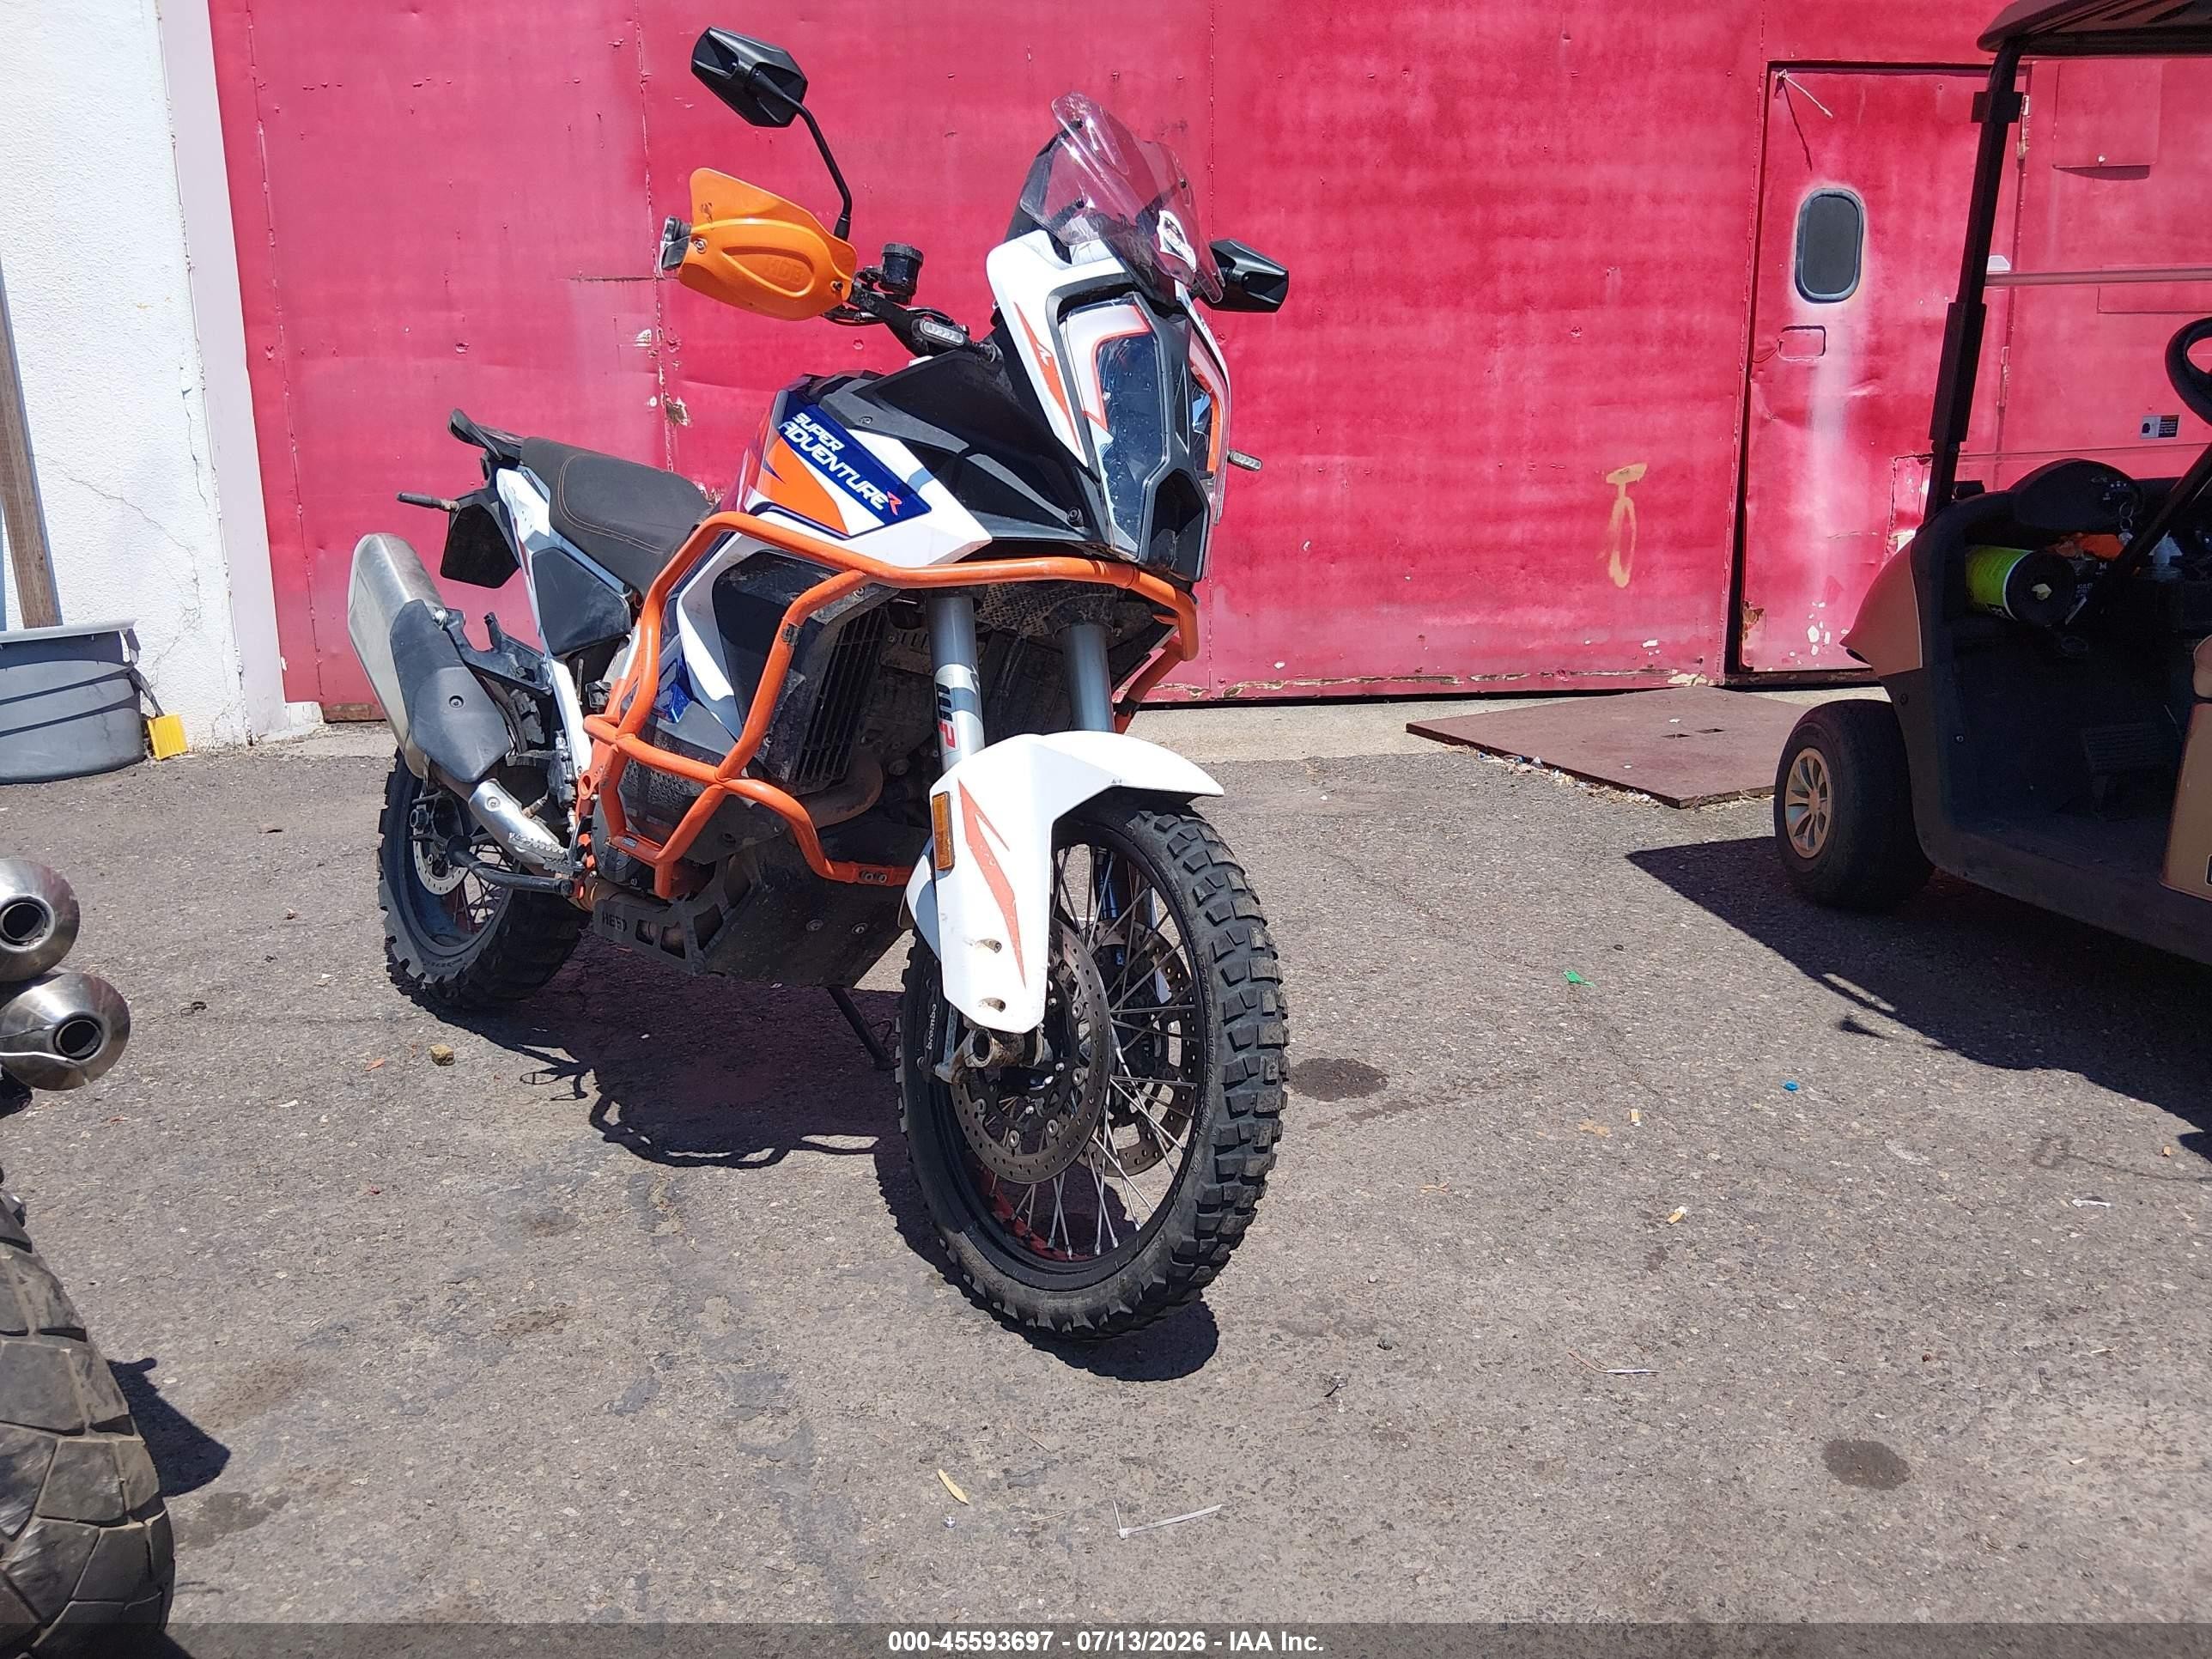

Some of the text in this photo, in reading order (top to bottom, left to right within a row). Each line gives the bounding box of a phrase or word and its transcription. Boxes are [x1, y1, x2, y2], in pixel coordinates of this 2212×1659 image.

[793, 412, 844, 452] SUPER
[778, 422, 889, 511] ADVENTURE
[926, 1003, 937, 1050] brembo
